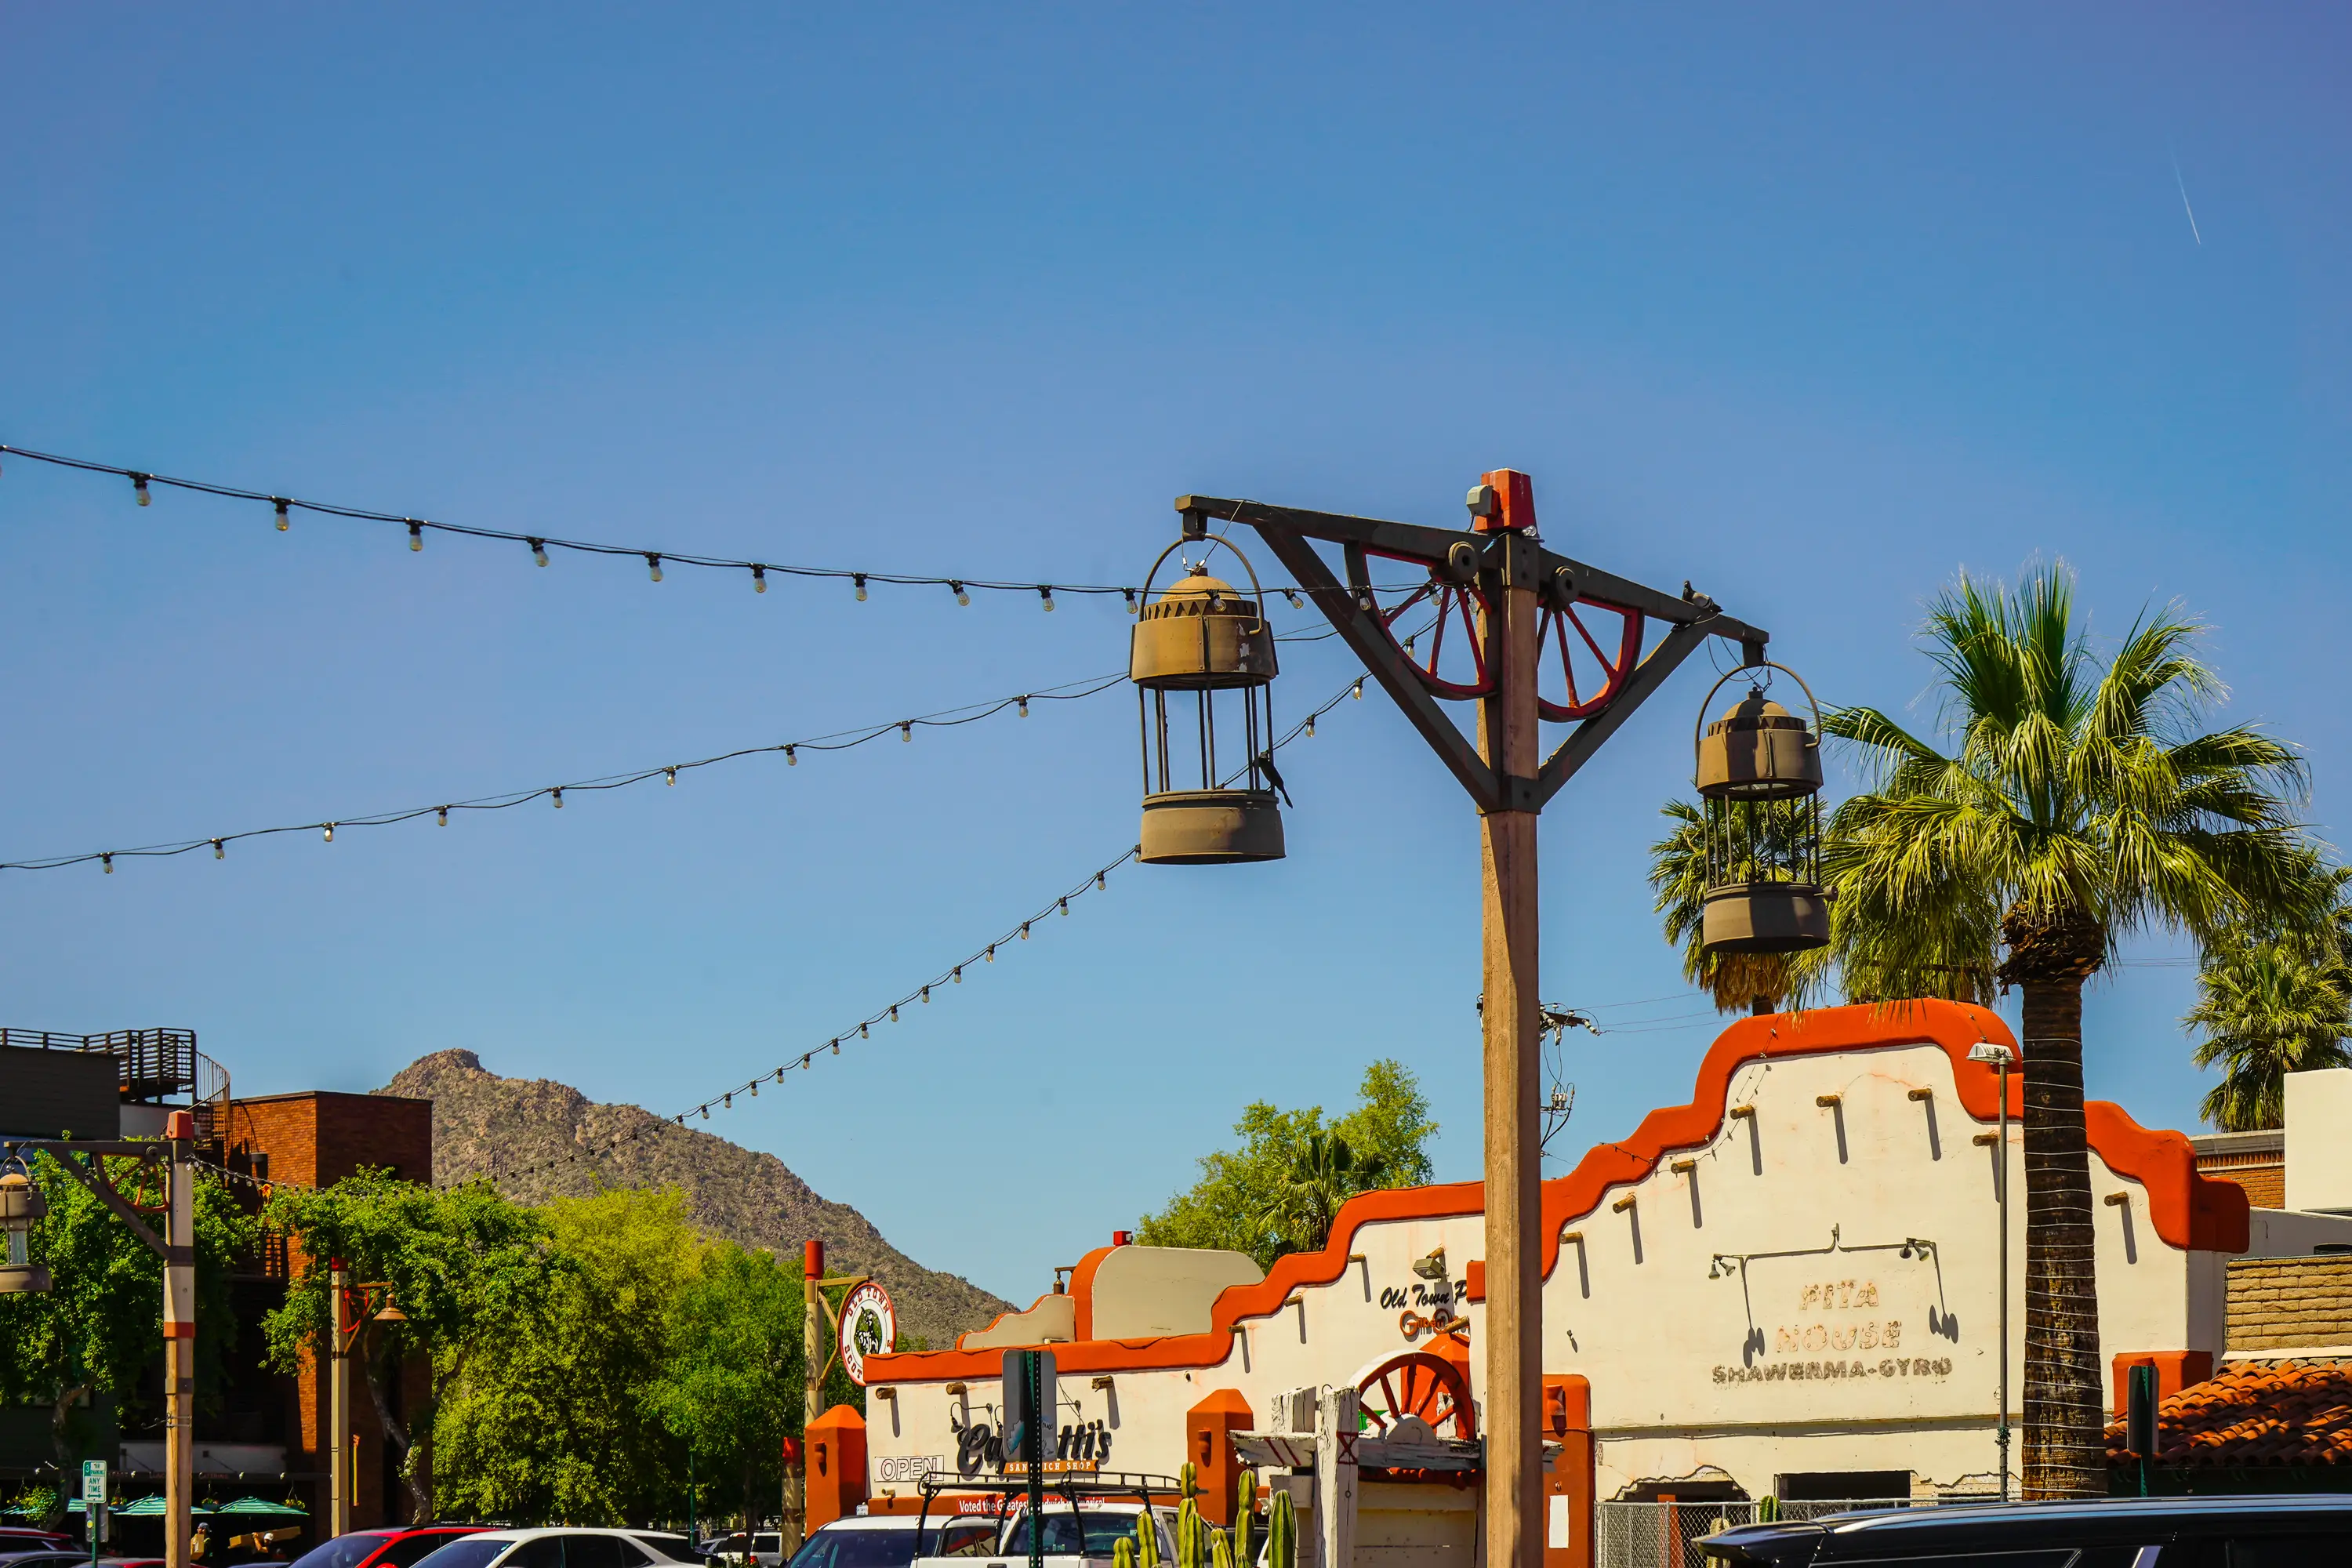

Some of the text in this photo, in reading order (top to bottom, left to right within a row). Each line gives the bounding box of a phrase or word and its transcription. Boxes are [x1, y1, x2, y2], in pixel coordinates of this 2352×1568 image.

[848, 1287, 890, 1317] OLD TOWN
[1380, 1287, 1407, 1309] Old
[1412, 1283, 1450, 1307] Town
[1798, 1279, 1879, 1310] PITA
[880, 1457, 938, 1481] OPEN
[1009, 1461, 1091, 1472] SANICH SHOP
[959, 1498, 982, 1513] Voted
[985, 1498, 996, 1512] the
